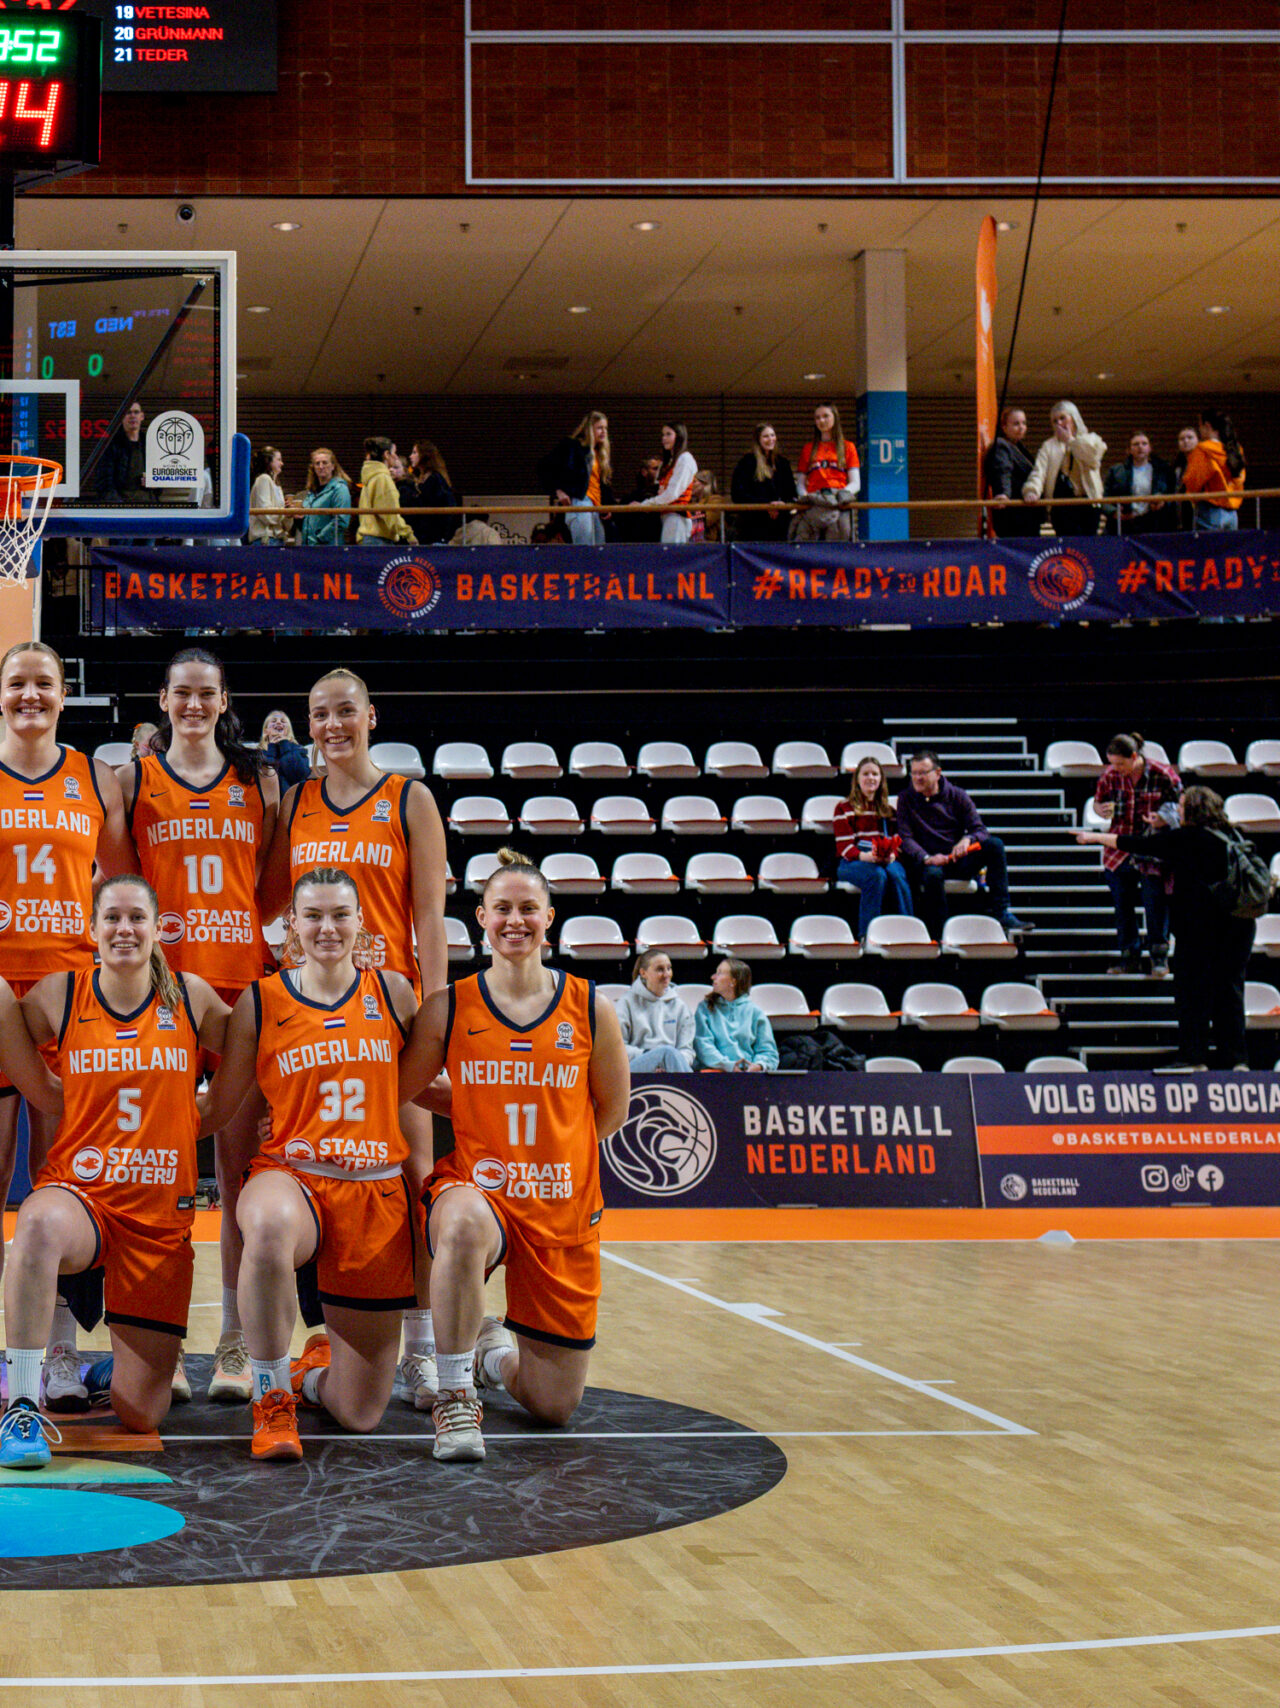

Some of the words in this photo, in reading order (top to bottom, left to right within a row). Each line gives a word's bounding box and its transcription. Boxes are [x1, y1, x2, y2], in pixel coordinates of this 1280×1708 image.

[115, 5, 134, 19] 19
[135, 6, 210, 19] VETESINA
[114, 26, 134, 40] 20
[135, 25, 223, 40] GRÜNMANN
[114, 47, 132, 61] 21
[135, 48, 189, 61] TEDER
[880, 439, 892, 464] D
[105, 572, 360, 602] BASKETBALL.NL
[457, 572, 714, 602] BASKETBALL.NL
[753, 567, 894, 600] #READY
[923, 565, 1007, 597] ROAR
[1117, 555, 1267, 593] #READY
[146, 818, 255, 847] NEDERLAND
[12, 844, 57, 885] 14
[292, 841, 393, 869] NEDERLAND
[183, 854, 224, 894] 10
[15, 899, 83, 917] STAATS
[186, 909, 251, 927] STAATS
[15, 915, 85, 936] LOTERIJ
[186, 925, 253, 944] LOTERIJ
[70, 1047, 188, 1074] NEDERLAND
[276, 1038, 392, 1078] NEDERLAND
[460, 1060, 579, 1088] NEDERLAND
[117, 1088, 142, 1132] 5
[319, 1078, 365, 1122] 32
[1024, 1084, 1095, 1114] VOLG
[1104, 1083, 1157, 1113] ONS
[1165, 1083, 1198, 1113] OP
[504, 1102, 538, 1146] 11
[743, 1105, 952, 1136] BASKETBALL
[106, 1146, 179, 1167] STAATS
[319, 1138, 388, 1159] STAATS
[746, 1143, 936, 1174] NEDERLAND
[104, 1165, 177, 1185] LOTERIJ
[506, 1161, 571, 1180] STAATS
[1032, 1178, 1080, 1187] BASKETBALL
[506, 1178, 572, 1198] LOTERIJ
[1033, 1187, 1077, 1196] NEDERLAND
